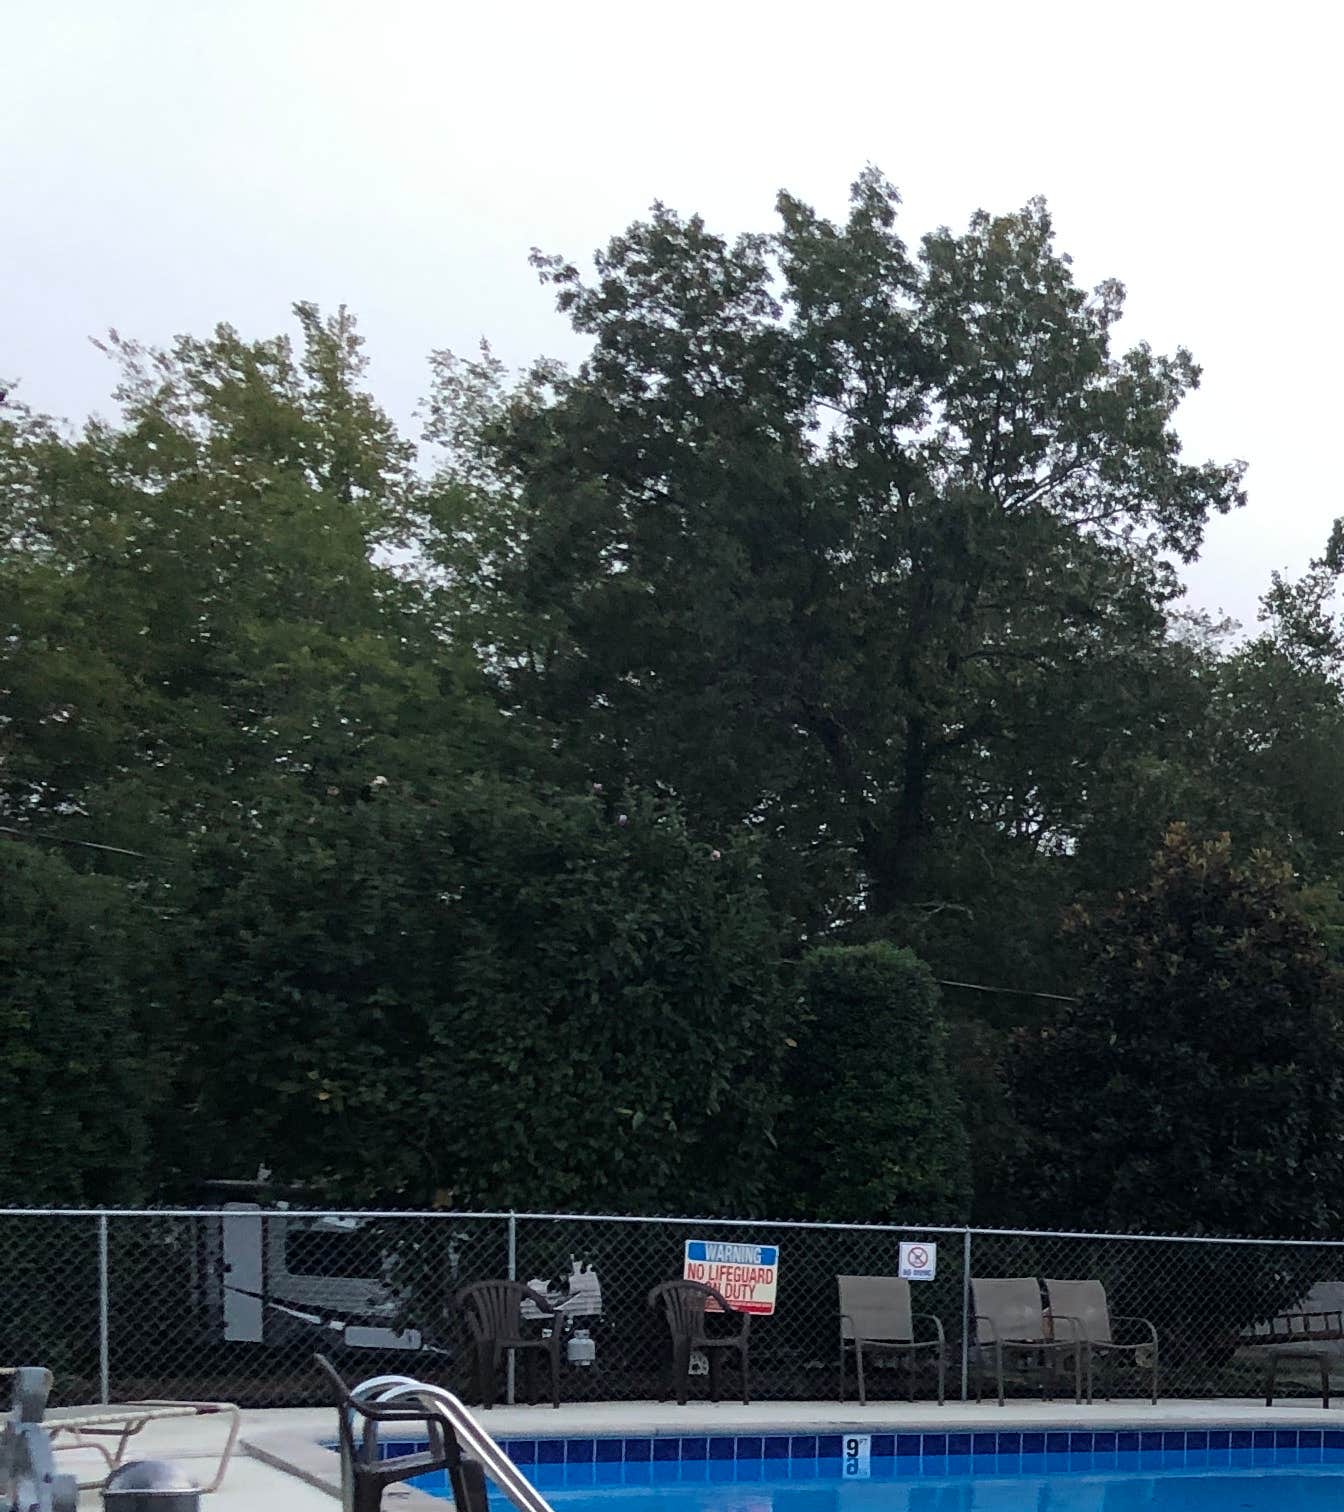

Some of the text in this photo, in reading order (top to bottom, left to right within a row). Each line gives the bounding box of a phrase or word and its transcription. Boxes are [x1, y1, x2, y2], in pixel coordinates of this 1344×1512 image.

[705, 1243, 762, 1264] WARNING
[687, 1263, 774, 1285] NO LIFEGUARD
[724, 1283, 756, 1299] DUTY
[846, 1438, 859, 1458] 9
